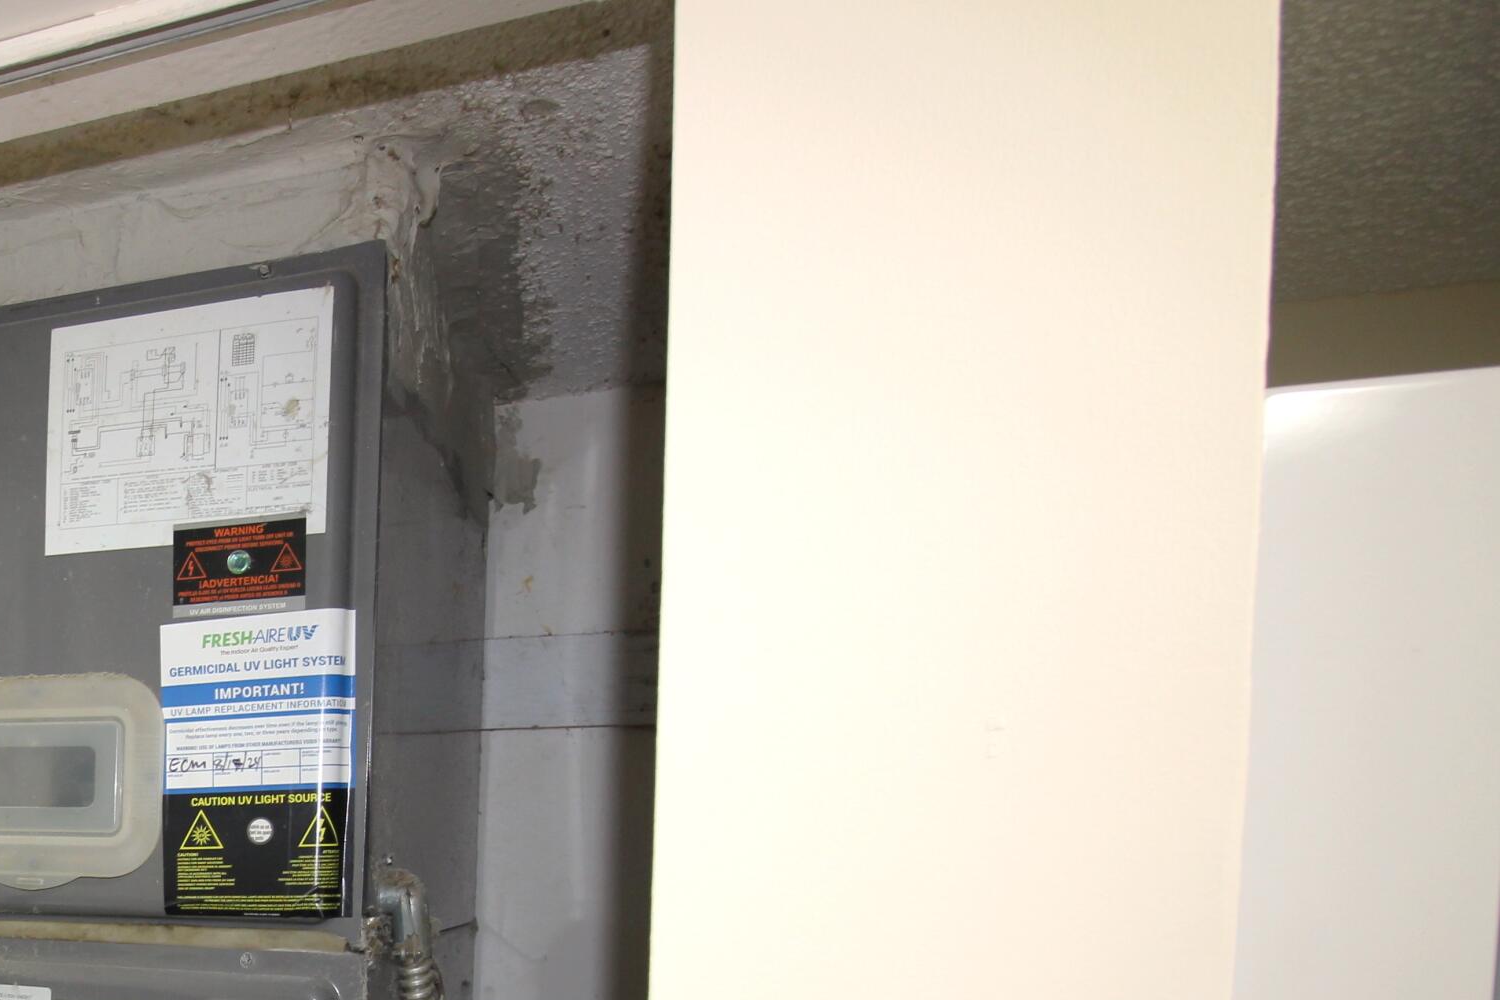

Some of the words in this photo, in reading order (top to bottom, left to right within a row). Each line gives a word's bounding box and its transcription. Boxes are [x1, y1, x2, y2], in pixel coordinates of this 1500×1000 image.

[213, 524, 265, 537] WARNING
[190, 608, 201, 616] UV
[212, 604, 258, 613] DISINFECTION
[169, 662, 240, 678] GERMICIDAL
[243, 660, 261, 672] UV
[263, 657, 299, 670] LIGHT
[214, 681, 306, 701] IMPORTANT!
[170, 708, 183, 717] UV
[185, 706, 212, 716] LAMP
[214, 702, 283, 714] REPLACEMENT
[191, 796, 237, 807] CAUTION
[237, 795, 253, 806] UV
[254, 794, 286, 805] LIGHT
